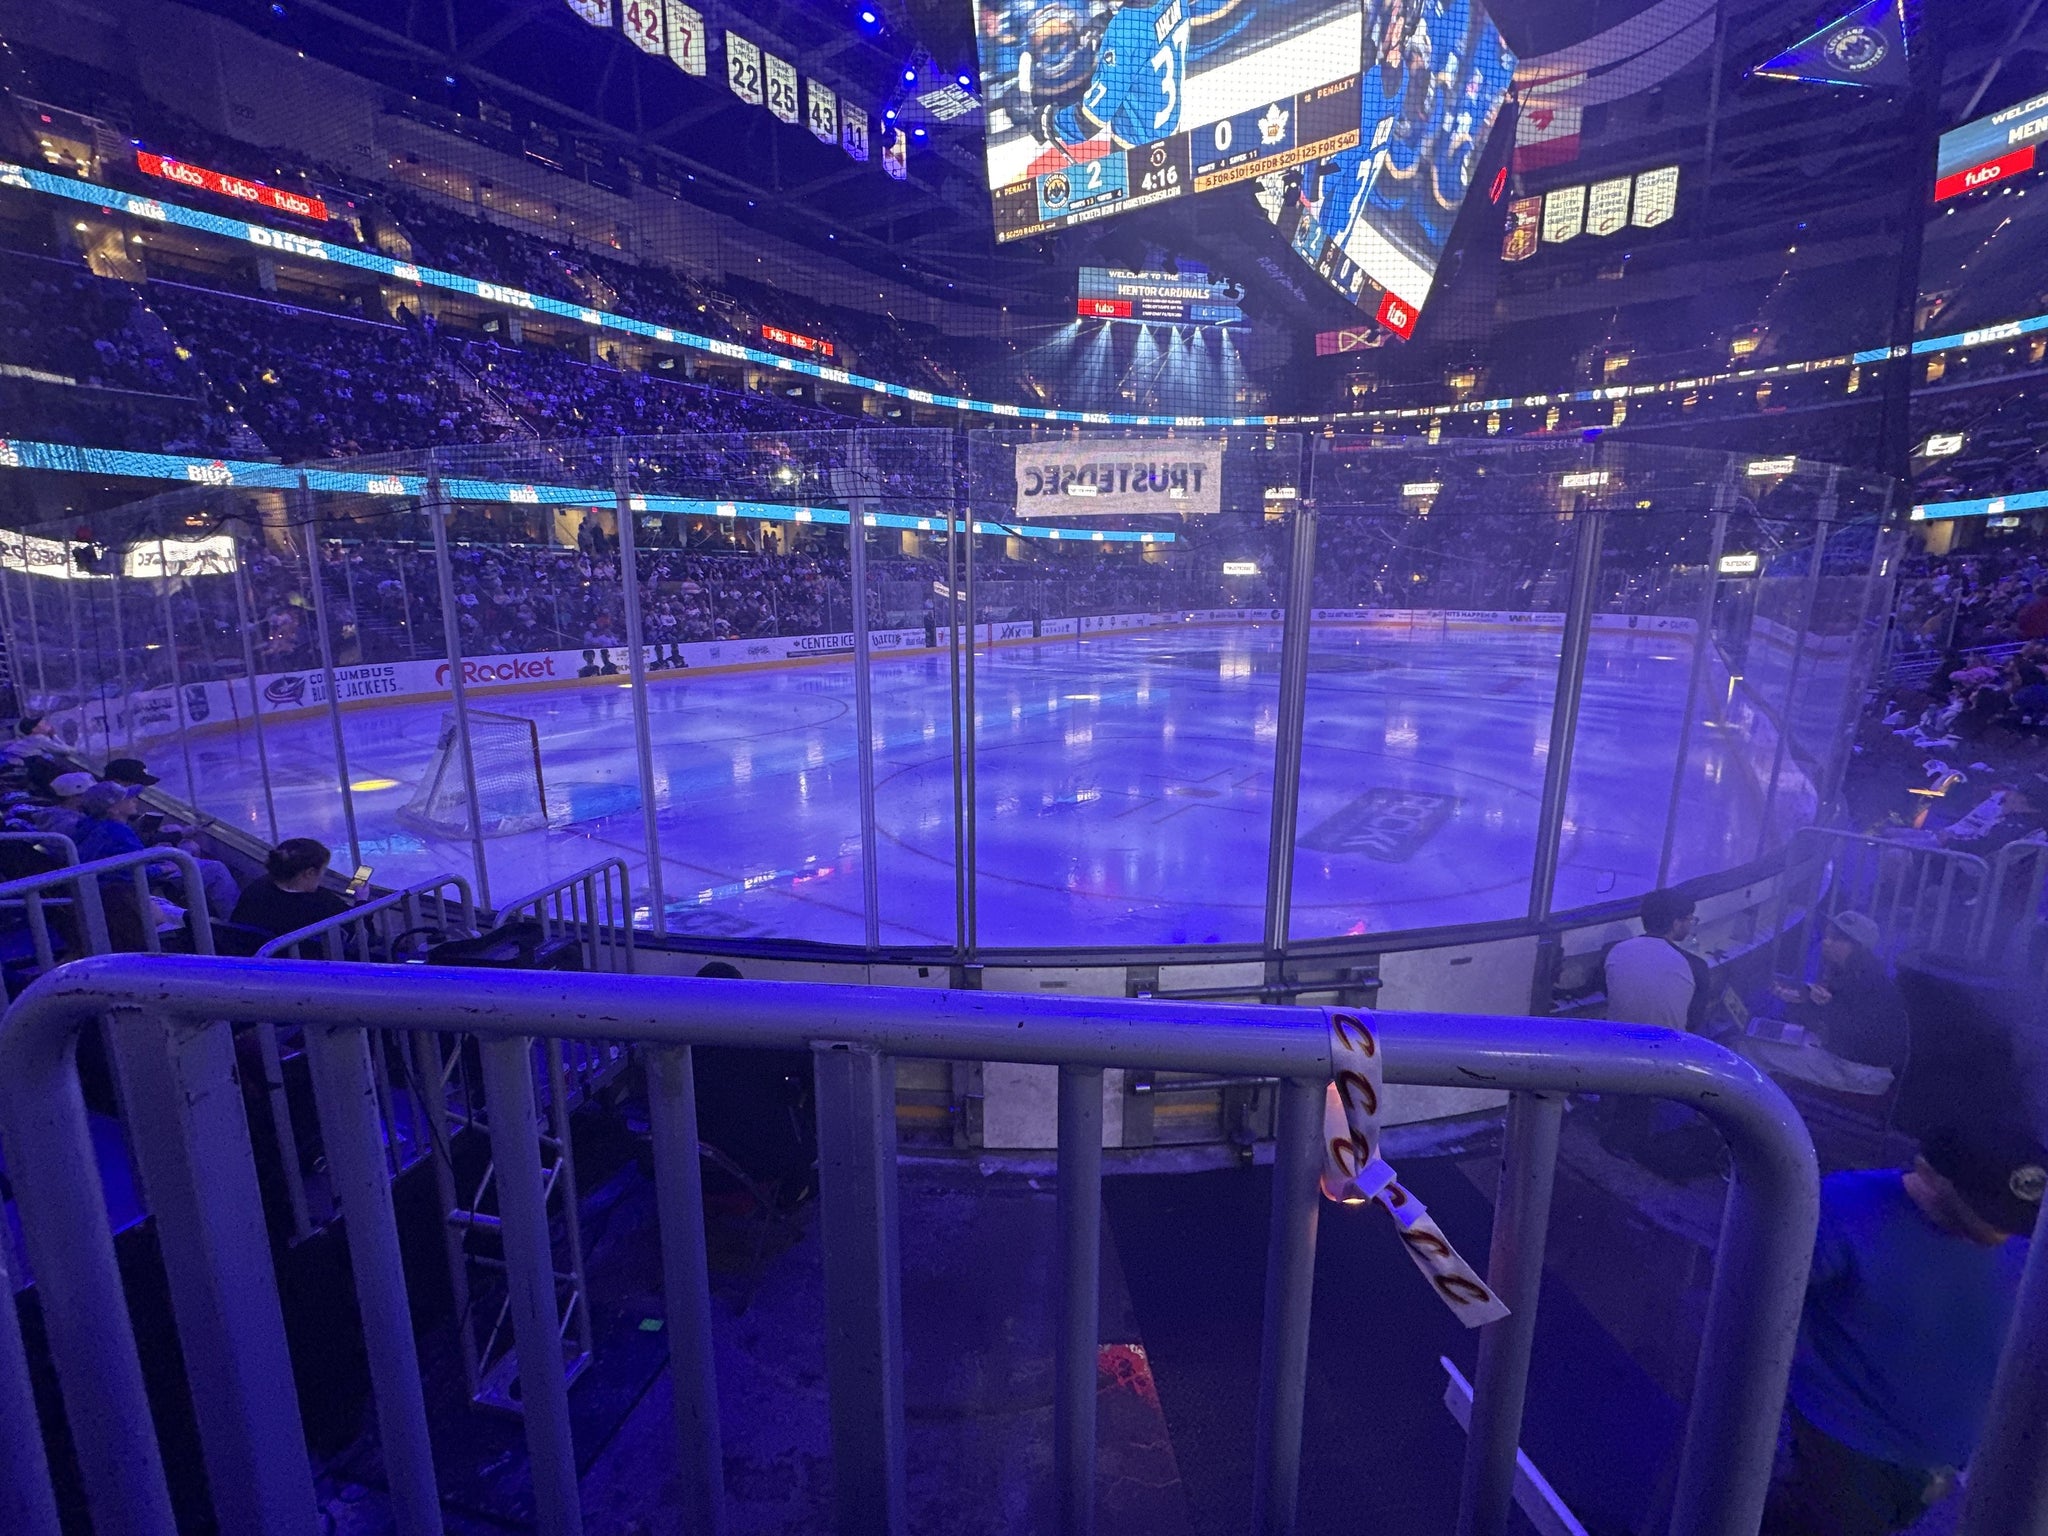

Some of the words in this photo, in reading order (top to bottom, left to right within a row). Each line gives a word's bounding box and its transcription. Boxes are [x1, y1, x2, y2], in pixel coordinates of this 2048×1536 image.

[627, 1, 659, 43] 42
[680, 27, 691, 57] 7
[732, 57, 759, 95] 22
[1317, 78, 1355, 99] PENALTY
[771, 78, 796, 113] 25
[812, 101, 833, 134] 43
[1992, 95, 2048, 125] WELCO
[848, 122, 863, 152] 11
[1214, 120, 1232, 151] 0
[2008, 115, 2048, 144] MEN
[1212, 173, 1229, 185] FOR
[1230, 167, 1245, 181] $10
[1261, 158, 1278, 171] FOR
[1279, 153, 1296, 169] $20
[1302, 145, 1317, 158] 125
[1318, 141, 1336, 154] FOR
[1337, 135, 1356, 149] $40
[161, 161, 203, 185] fubo
[1086, 161, 1103, 190] 2
[1142, 166, 1178, 191] 4:16
[1965, 166, 2001, 187] fubo
[220, 178, 259, 200] fubo
[1005, 182, 1032, 196] PENALTY
[274, 192, 310, 214] fubo
[1164, 273, 1179, 281] THE
[1118, 284, 1156, 297] MENTOR
[1158, 286, 1210, 299] CARDINALS
[1524, 395, 1547, 406] 4:16
[801, 635, 839, 650] CENTER
[841, 634, 854, 647] ICE
[309, 666, 395, 685] COLUMBUS
[463, 656, 556, 684] Rocket
[346, 678, 397, 698] JACKETS
